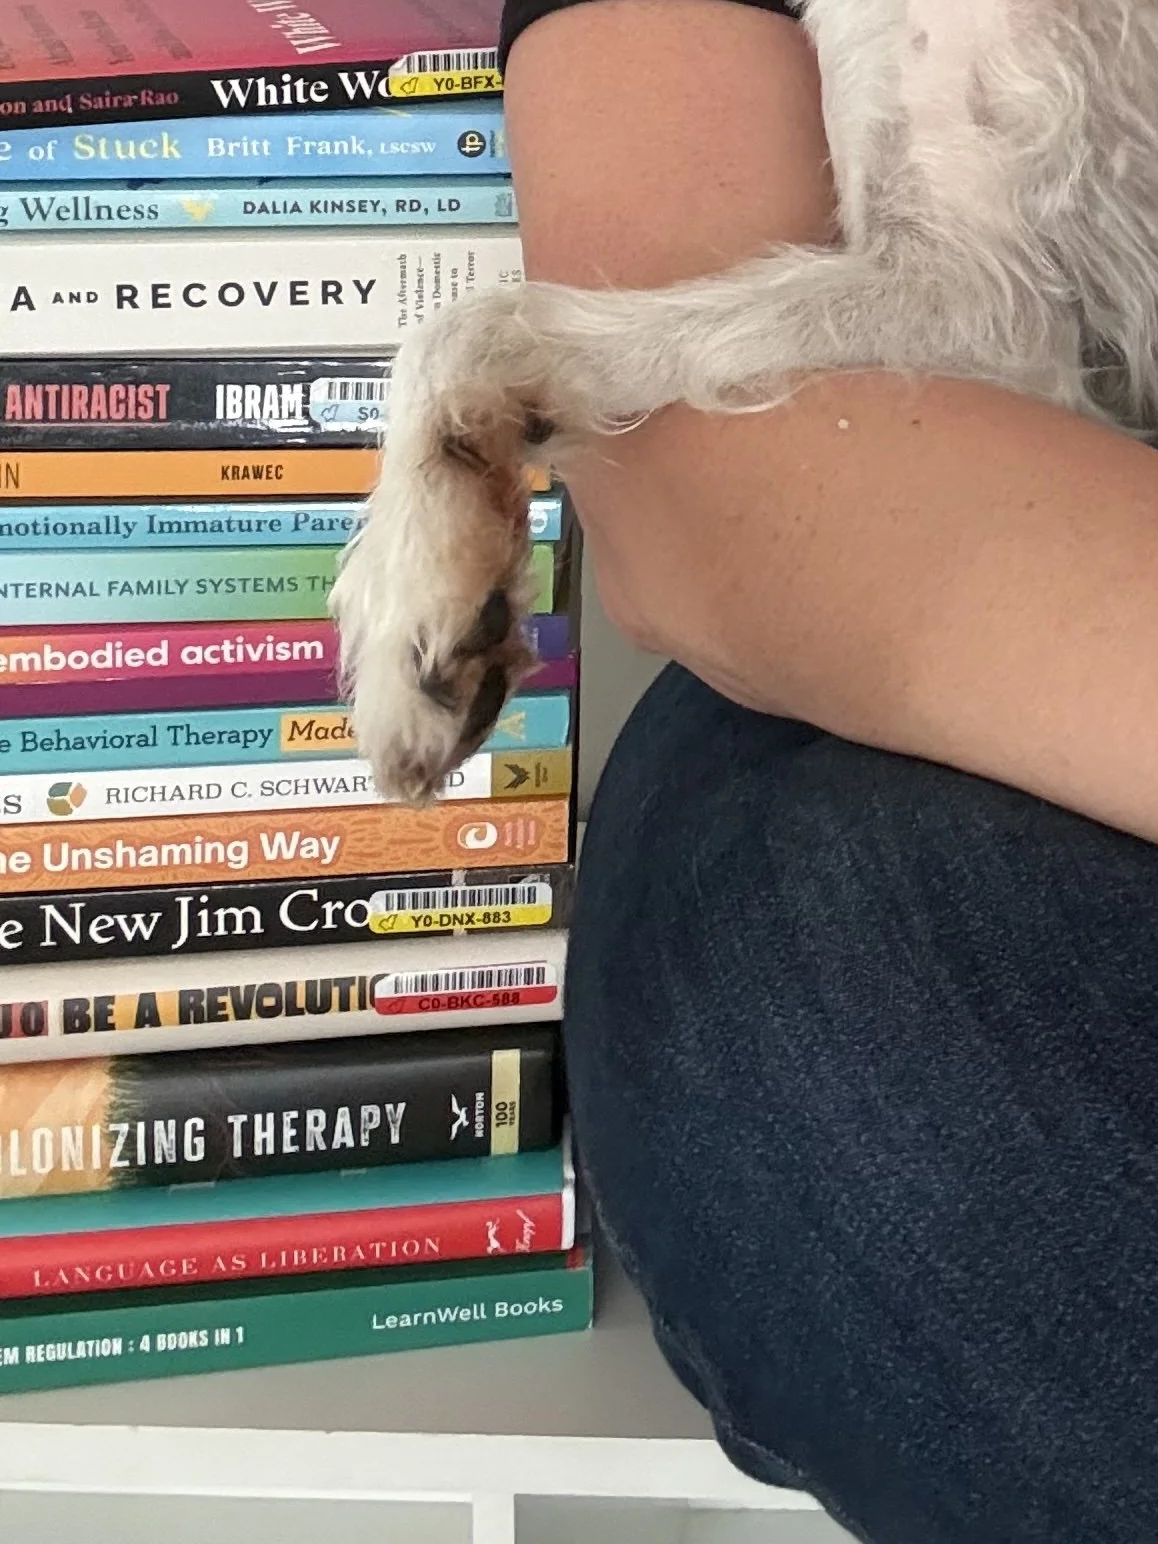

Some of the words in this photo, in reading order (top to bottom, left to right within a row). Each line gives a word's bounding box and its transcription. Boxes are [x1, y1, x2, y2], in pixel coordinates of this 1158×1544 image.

[32, 94, 73, 113] and
[79, 90, 133, 111] Saira
[139, 88, 180, 106] Rao
[210, 73, 329, 109] White
[28, 139, 58, 161] of
[74, 131, 182, 160] Stuck
[207, 136, 271, 157] Britt
[286, 135, 373, 157] Frank,
[19, 196, 160, 223] Wellness
[243, 200, 300, 216] DALIA
[310, 199, 387, 216] KINSEY,
[395, 199, 429, 216] RD,
[437, 198, 461, 212] LD
[52, 291, 99, 304] AND
[115, 279, 377, 310] RECOVERY
[4, 384, 171, 420] ANTIRACIST
[215, 384, 303, 420] IBRAM
[220, 465, 284, 481] KRAWEC
[147, 513, 282, 535] Immature
[107, 578, 190, 598] FAMILY
[196, 575, 299, 594] SYSTEMS
[180, 634, 325, 665] activism
[20, 725, 158, 753] Behavioral
[167, 724, 274, 749] Therapy
[105, 782, 222, 805] RICHARD
[230, 780, 252, 799] C.
[259, 775, 374, 798] SCHWAR
[43, 835, 249, 873] Unshaming
[259, 830, 341, 865] Way
[40, 902, 163, 947] New
[171, 894, 265, 951] Jim
[279, 888, 371, 930] Cro
[61, 995, 117, 1036] BE
[134, 992, 162, 1029] A
[178, 974, 378, 1026] REVOLUTI
[474, 1091, 485, 1138] NORTON
[495, 1101, 508, 1128] 100
[0, 1116, 206, 1177] LONIZING
[227, 1101, 407, 1158] THERAPY
[33, 1256, 198, 1288] LANGUAGE
[213, 1254, 247, 1272] AS
[260, 1237, 442, 1269] LIBERATION
[372, 1302, 487, 1330] LearnWell
[495, 1296, 564, 1318] Books
[25, 1337, 123, 1364] REGULATION
[140, 1336, 150, 1353] 4
[157, 1333, 209, 1350] BOOKS
[215, 1330, 232, 1346] IN
[236, 1327, 245, 1344] 1
